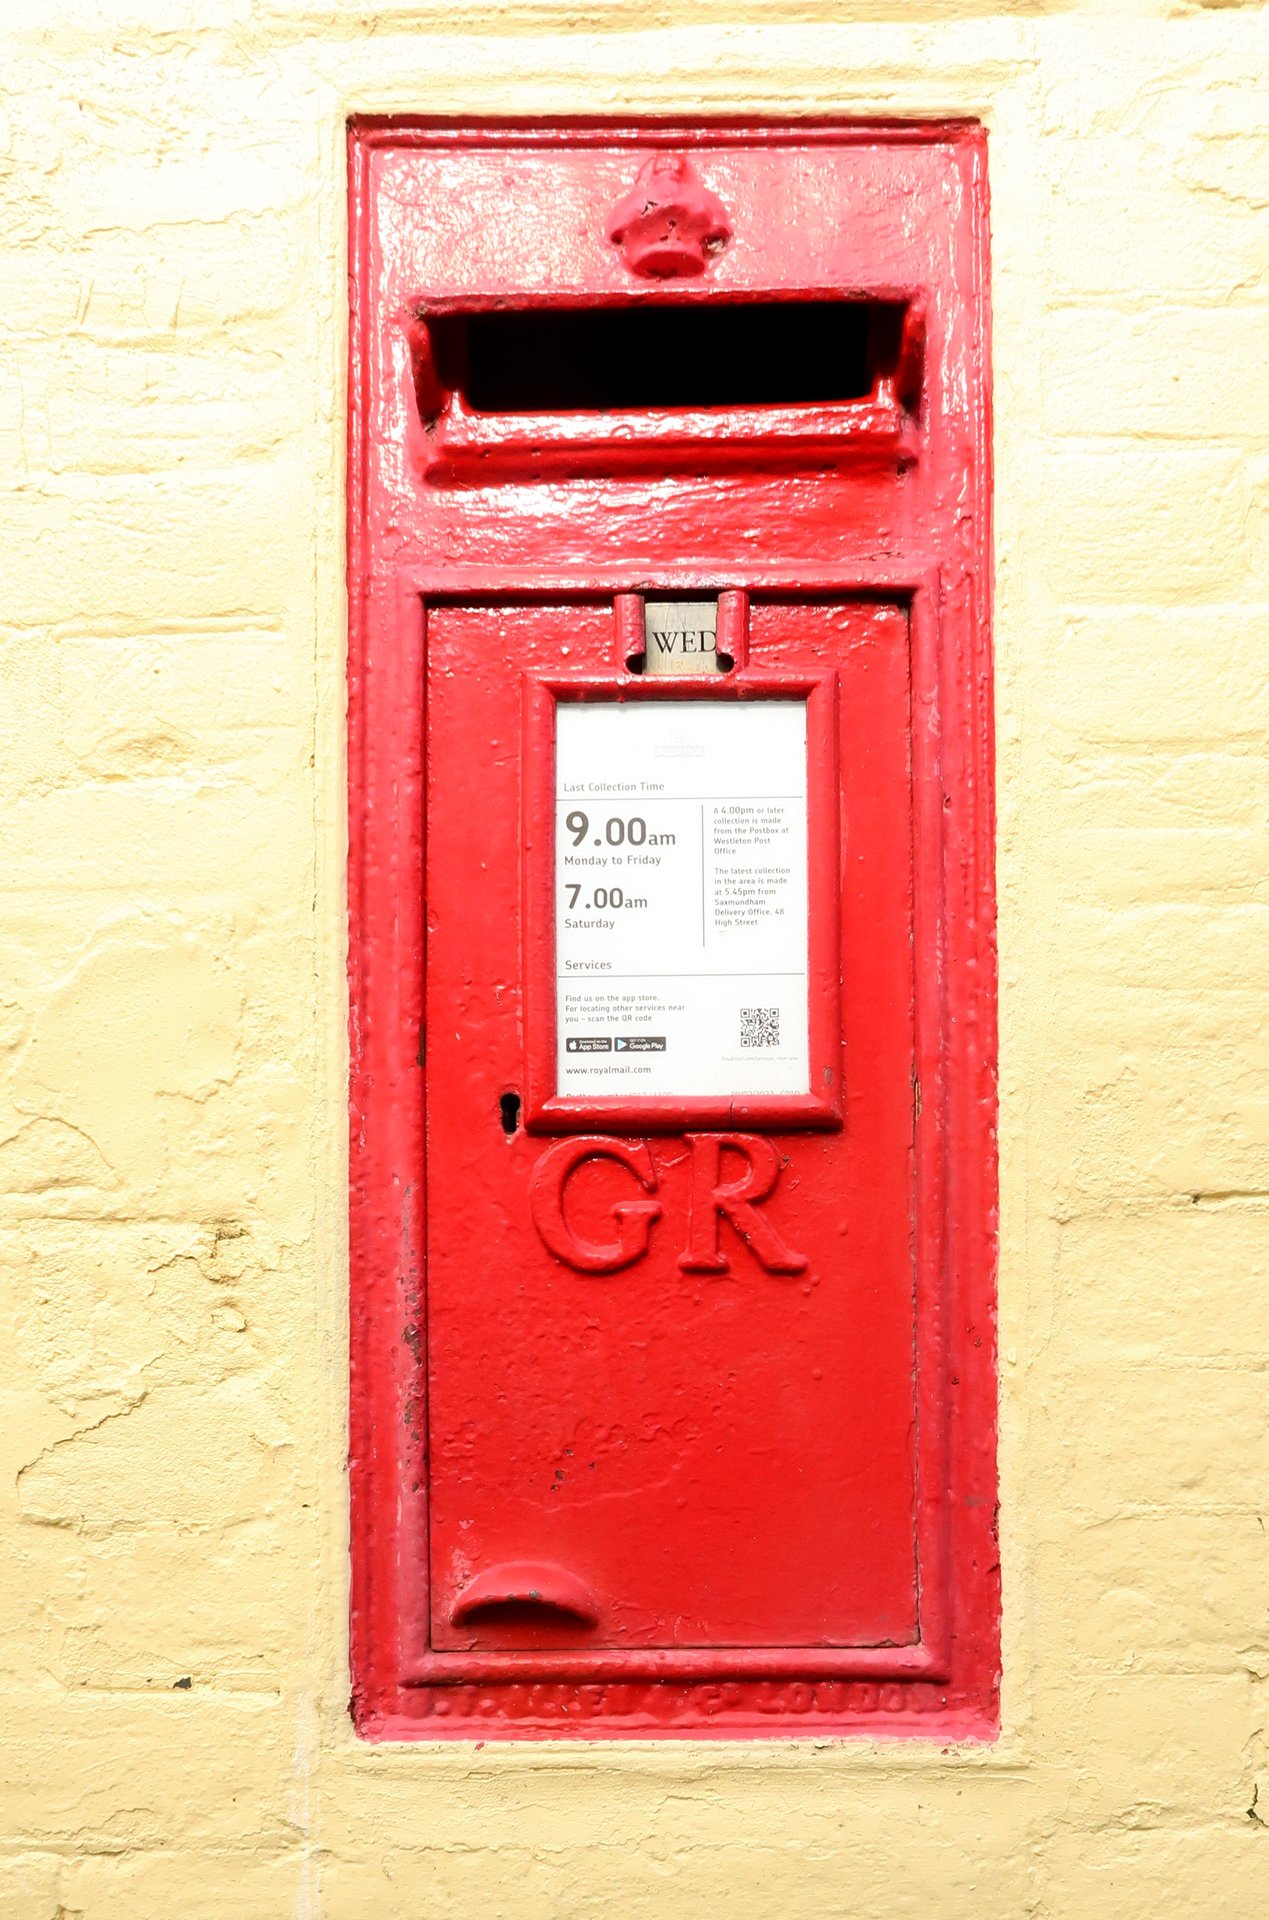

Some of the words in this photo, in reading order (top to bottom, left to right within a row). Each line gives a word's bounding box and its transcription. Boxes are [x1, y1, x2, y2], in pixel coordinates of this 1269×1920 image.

[652, 631, 717, 654] WED
[563, 783, 585, 792] Last
[588, 782, 637, 792] Collection
[640, 781, 665, 791] Time
[713, 807, 719, 815] A
[721, 806, 755, 816] 4.00pm
[767, 807, 785, 815] later
[713, 816, 750, 825] collection
[752, 816, 759, 824] is
[760, 816, 782, 825] made
[565, 810, 676, 848] 9.00am
[713, 827, 733, 835] from
[749, 826, 779, 835] Postbox
[782, 826, 790, 834] at
[713, 837, 752, 845] Westleton
[754, 836, 771, 845] Post
[713, 847, 737, 855] Office
[564, 855, 608, 868] Monday
[611, 856, 623, 866] to
[627, 855, 662, 867] Friday
[714, 867, 729, 875] The
[730, 867, 753, 875] latest
[754, 867, 791, 875] collection
[714, 877, 722, 885] in
[723, 877, 737, 885] the
[739, 877, 756, 885] area
[766, 876, 788, 885] made
[564, 883, 648, 910] 7.00am
[714, 888, 723, 896] at
[724, 887, 756, 898] 5.45pm
[757, 887, 777, 896] from
[714, 897, 766, 906] Saxmundham
[714, 908, 746, 918] Delivery
[748, 908, 773, 917] Office,
[774, 907, 785, 916] 48
[564, 918, 615, 931] Saturday
[714, 918, 733, 928] High
[734, 918, 758, 927] Street
[565, 959, 612, 971] Services
[565, 994, 582, 1003] Find
[606, 994, 620, 1002] the
[621, 995, 636, 1004] app
[637, 994, 660, 1002] store.
[565, 1004, 578, 1013] For
[579, 1004, 611, 1014] locating
[612, 1004, 633, 1012] other
[634, 1004, 666, 1012] services
[564, 1016, 579, 1024] you
[587, 1015, 605, 1023] scan
[606, 1014, 620, 1022] the
[621, 1014, 633, 1022] QR
[634, 1014, 653, 1022] code
[579, 1043, 592, 1051] App
[592, 1043, 609, 1051] Store
[629, 1042, 651, 1051] Google
[651, 1042, 664, 1050] Play
[565, 1065, 652, 1076] www.royalmail.com
[530, 1132, 809, 1276] GR
